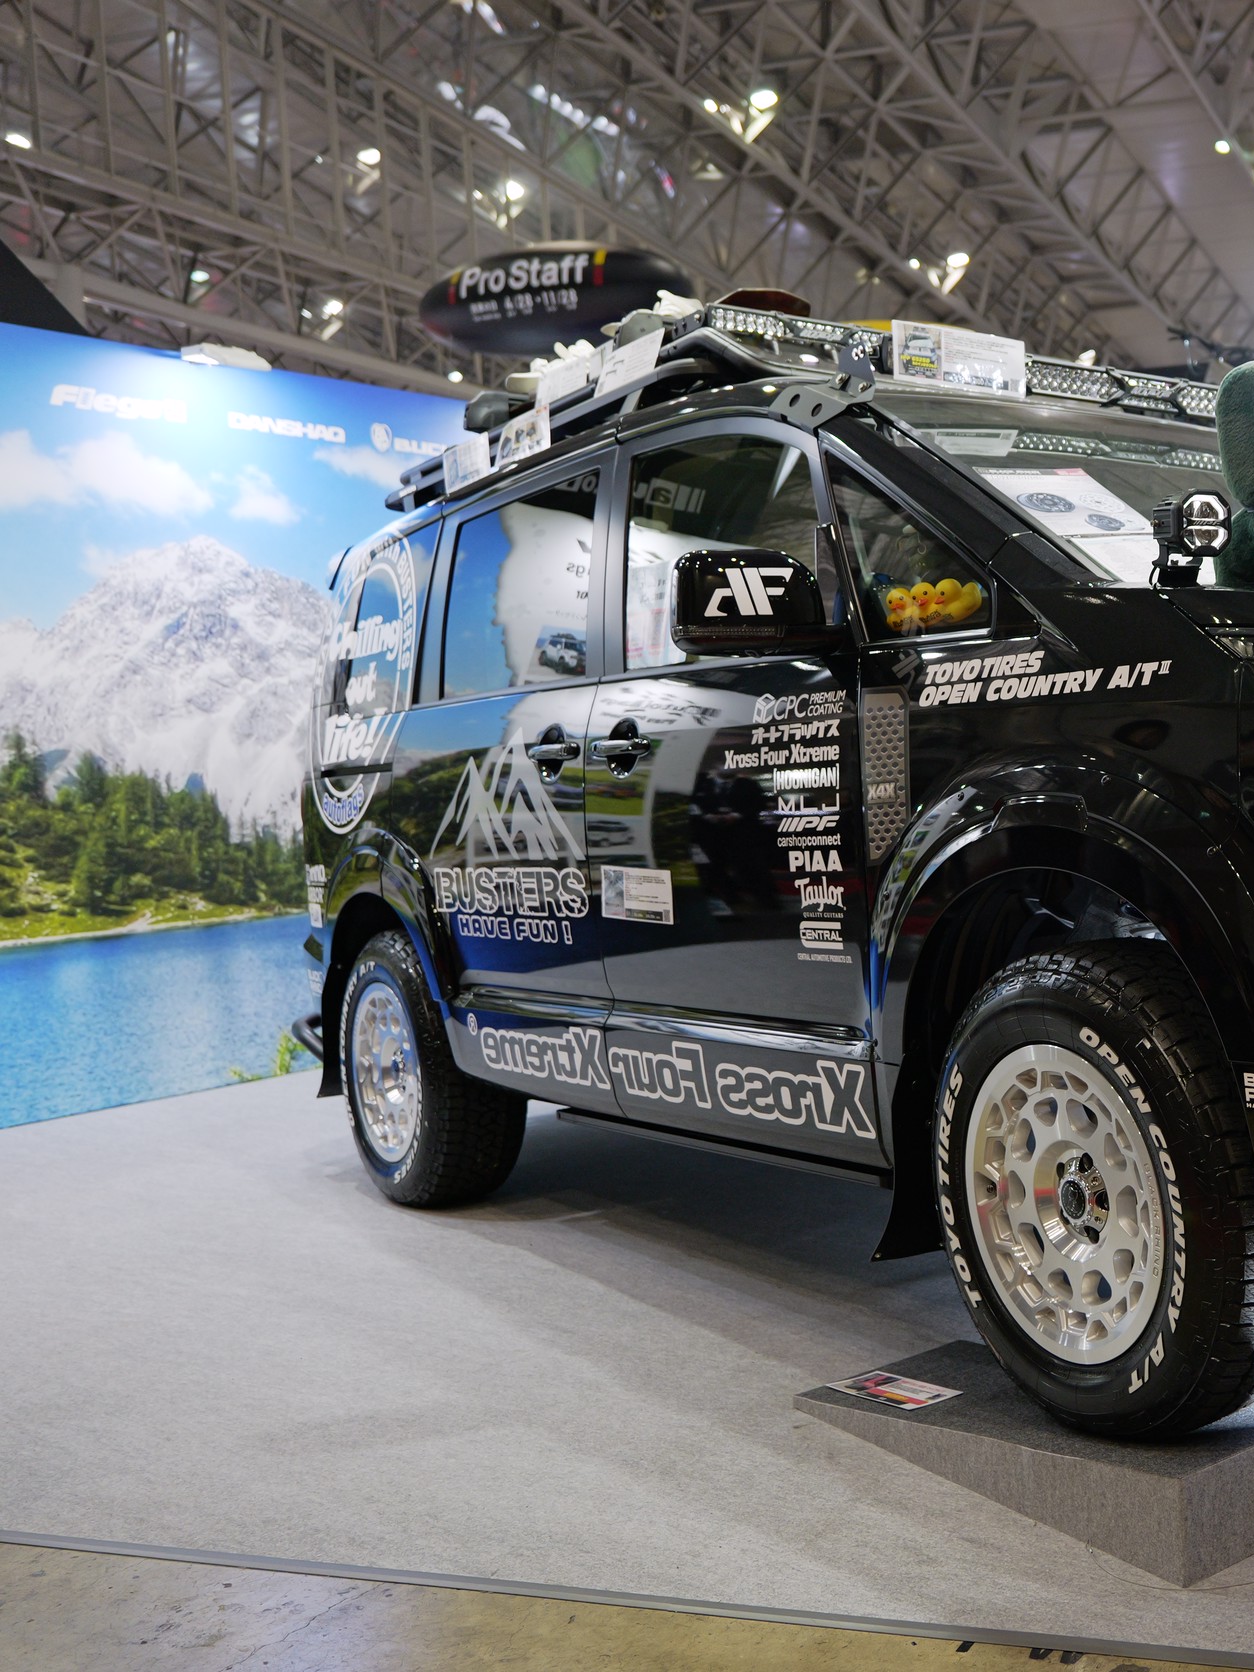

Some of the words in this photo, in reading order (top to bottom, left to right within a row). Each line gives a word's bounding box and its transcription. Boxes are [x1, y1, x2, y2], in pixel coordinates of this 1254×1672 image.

[924, 658, 983, 685] TOYO
[981, 650, 1045, 678] TIRES
[809, 689, 847, 704] PREMIUM
[918, 681, 983, 707] OPEN
[985, 668, 1104, 701] COUNTRY
[773, 693, 810, 720] CPC
[807, 702, 844, 717] COATING
[724, 749, 759, 770] Xross
[760, 746, 790, 767] Four
[789, 743, 840, 764] Xtreme
[867, 782, 896, 801] X4X
[777, 833, 841, 849] carshopconnect
[788, 849, 843, 873] PIAA
[433, 866, 590, 918] BUSTERS
[794, 875, 846, 912] Taylor
[457, 914, 512, 940] HAVE
[513, 918, 559, 944] FUN
[802, 911, 823, 919] QUALITY
[799, 929, 843, 941] CENTRAL
[1079, 1026, 1152, 1114] OPEN
[936, 1063, 965, 1191] TIRES
[1143, 1162, 1160, 1221] BLACK
[1152, 1225, 1162, 1279] RHINO
[1148, 1122, 1186, 1334] COUNTRY
[938, 1198, 983, 1309] TOYO
[1128, 1331, 1167, 1394] A/T
